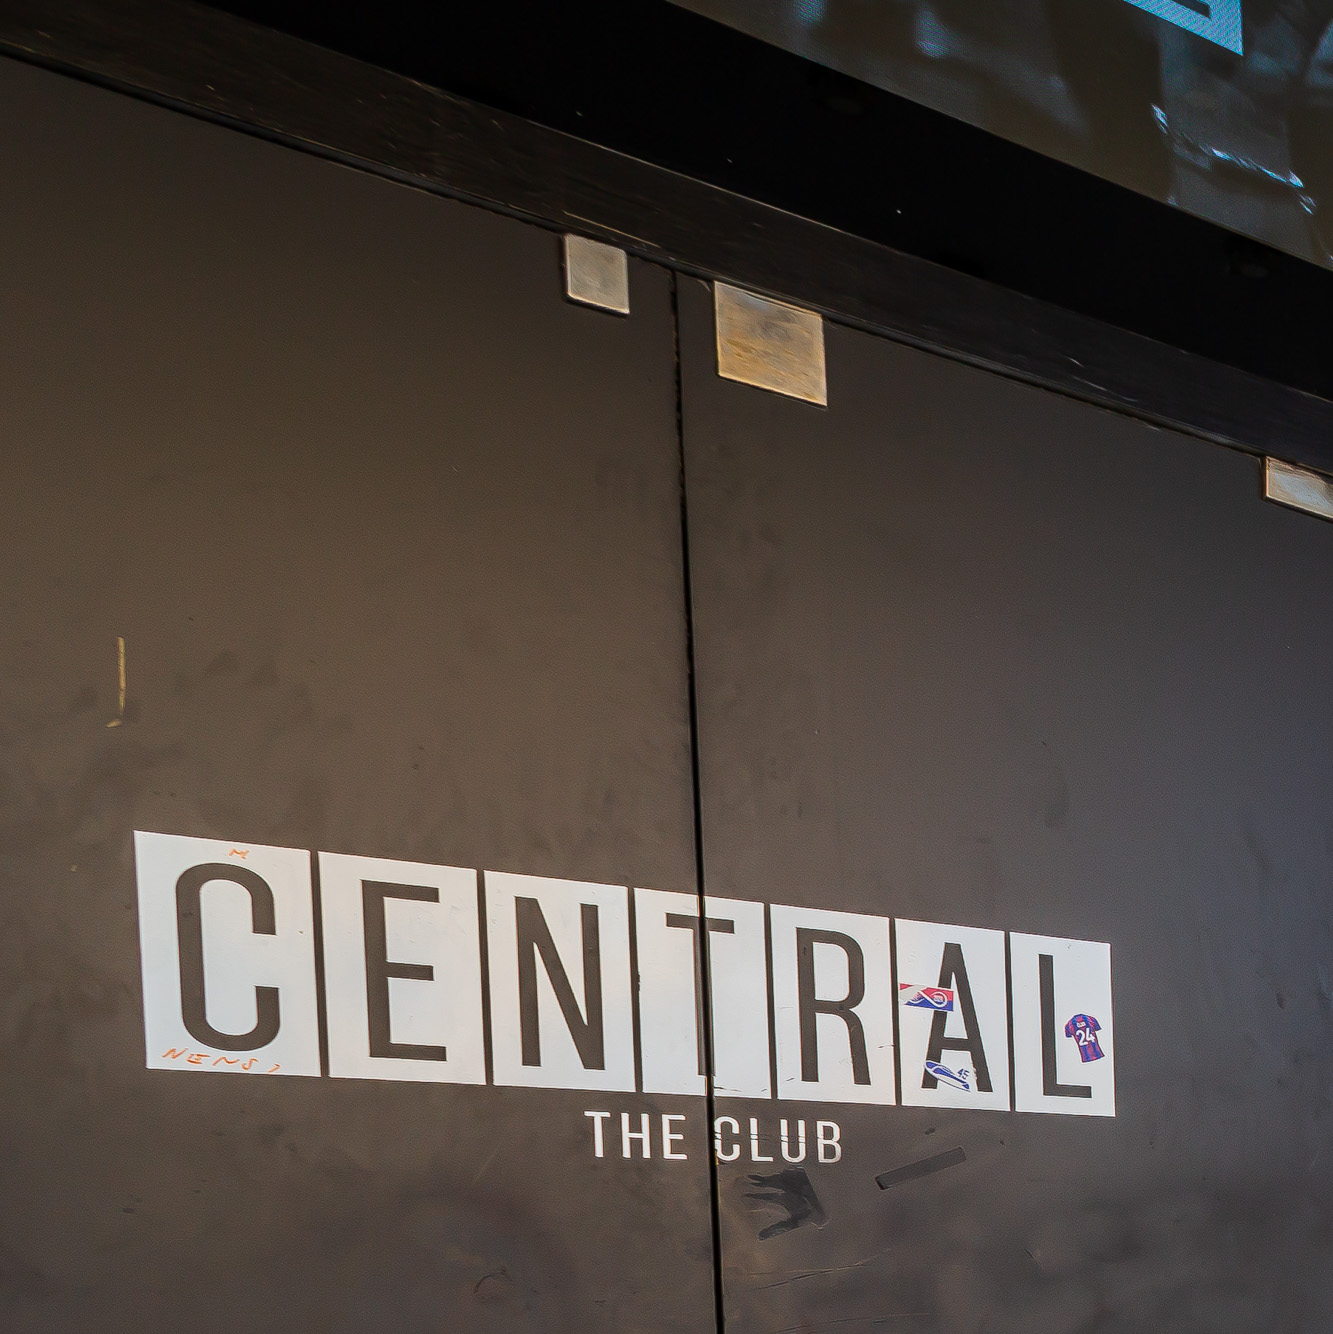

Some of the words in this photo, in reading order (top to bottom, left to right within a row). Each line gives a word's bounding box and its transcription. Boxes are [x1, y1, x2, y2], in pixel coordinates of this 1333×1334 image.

[175, 862, 1093, 1099] CENTRAL
[1076, 1027, 1096, 1047] 24
[584, 1111, 688, 1160] THE
[713, 1116, 842, 1163] CLUB
